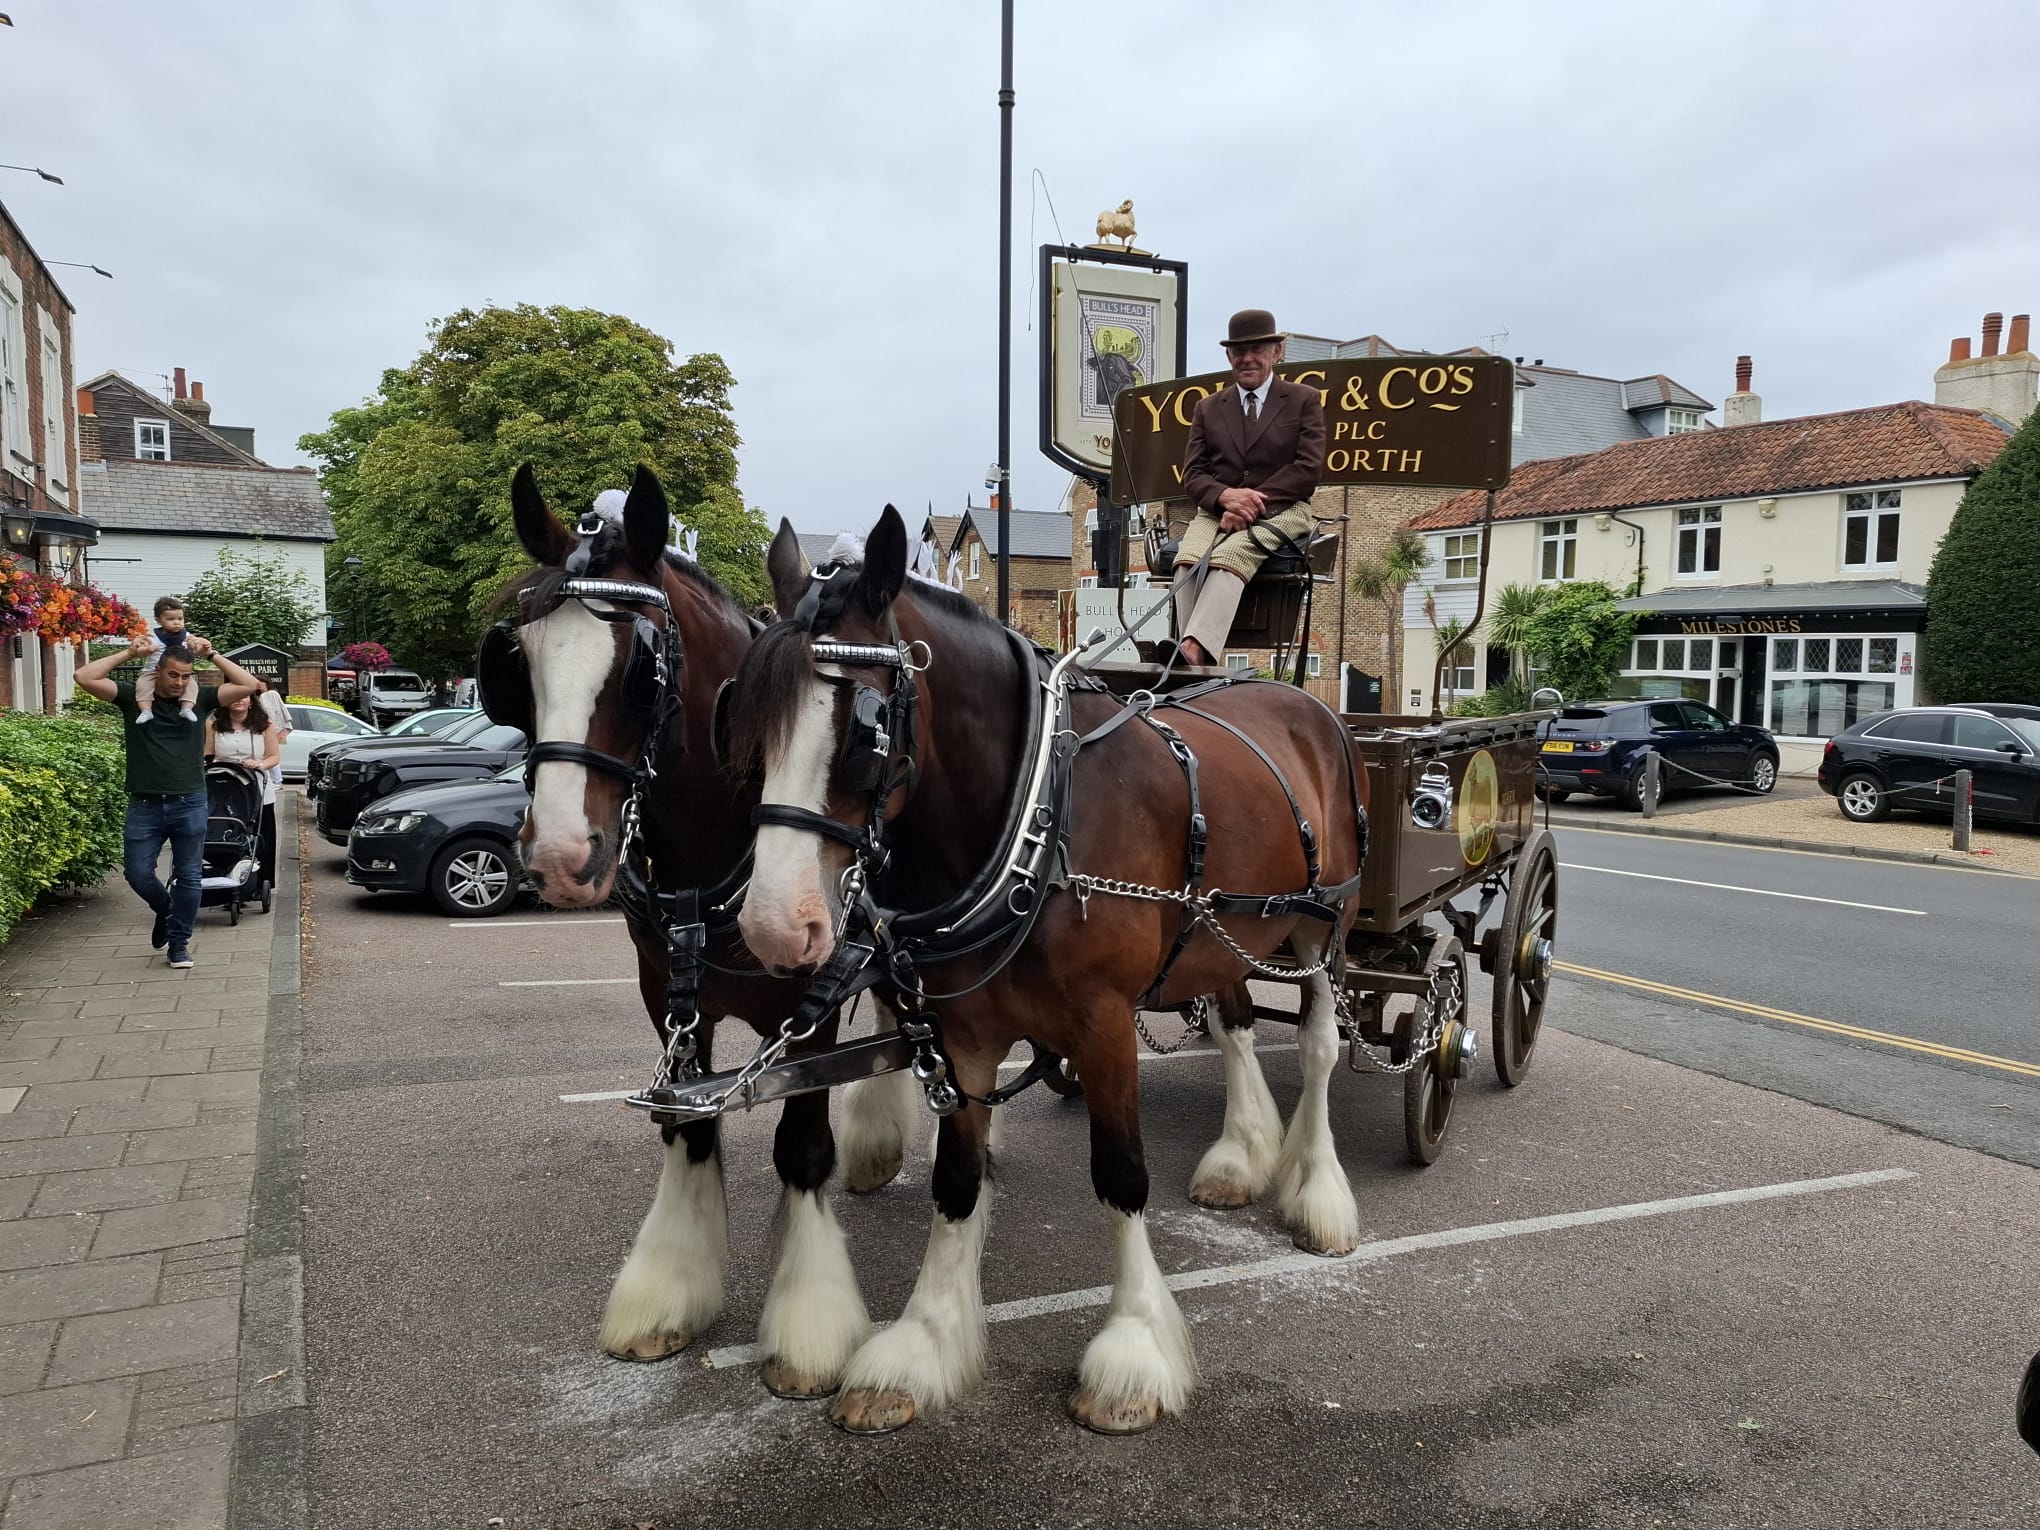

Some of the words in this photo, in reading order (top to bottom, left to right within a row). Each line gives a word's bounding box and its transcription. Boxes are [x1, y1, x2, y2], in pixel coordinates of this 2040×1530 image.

[1091, 301, 1118, 313] BULL'S
[1120, 304, 1143, 315] HEAD
[1139, 370, 1331, 433] YOG
[1334, 420, 1387, 440] PLC
[1681, 619, 1801, 634] MILESTONES
[257, 665, 278, 674] PARK
